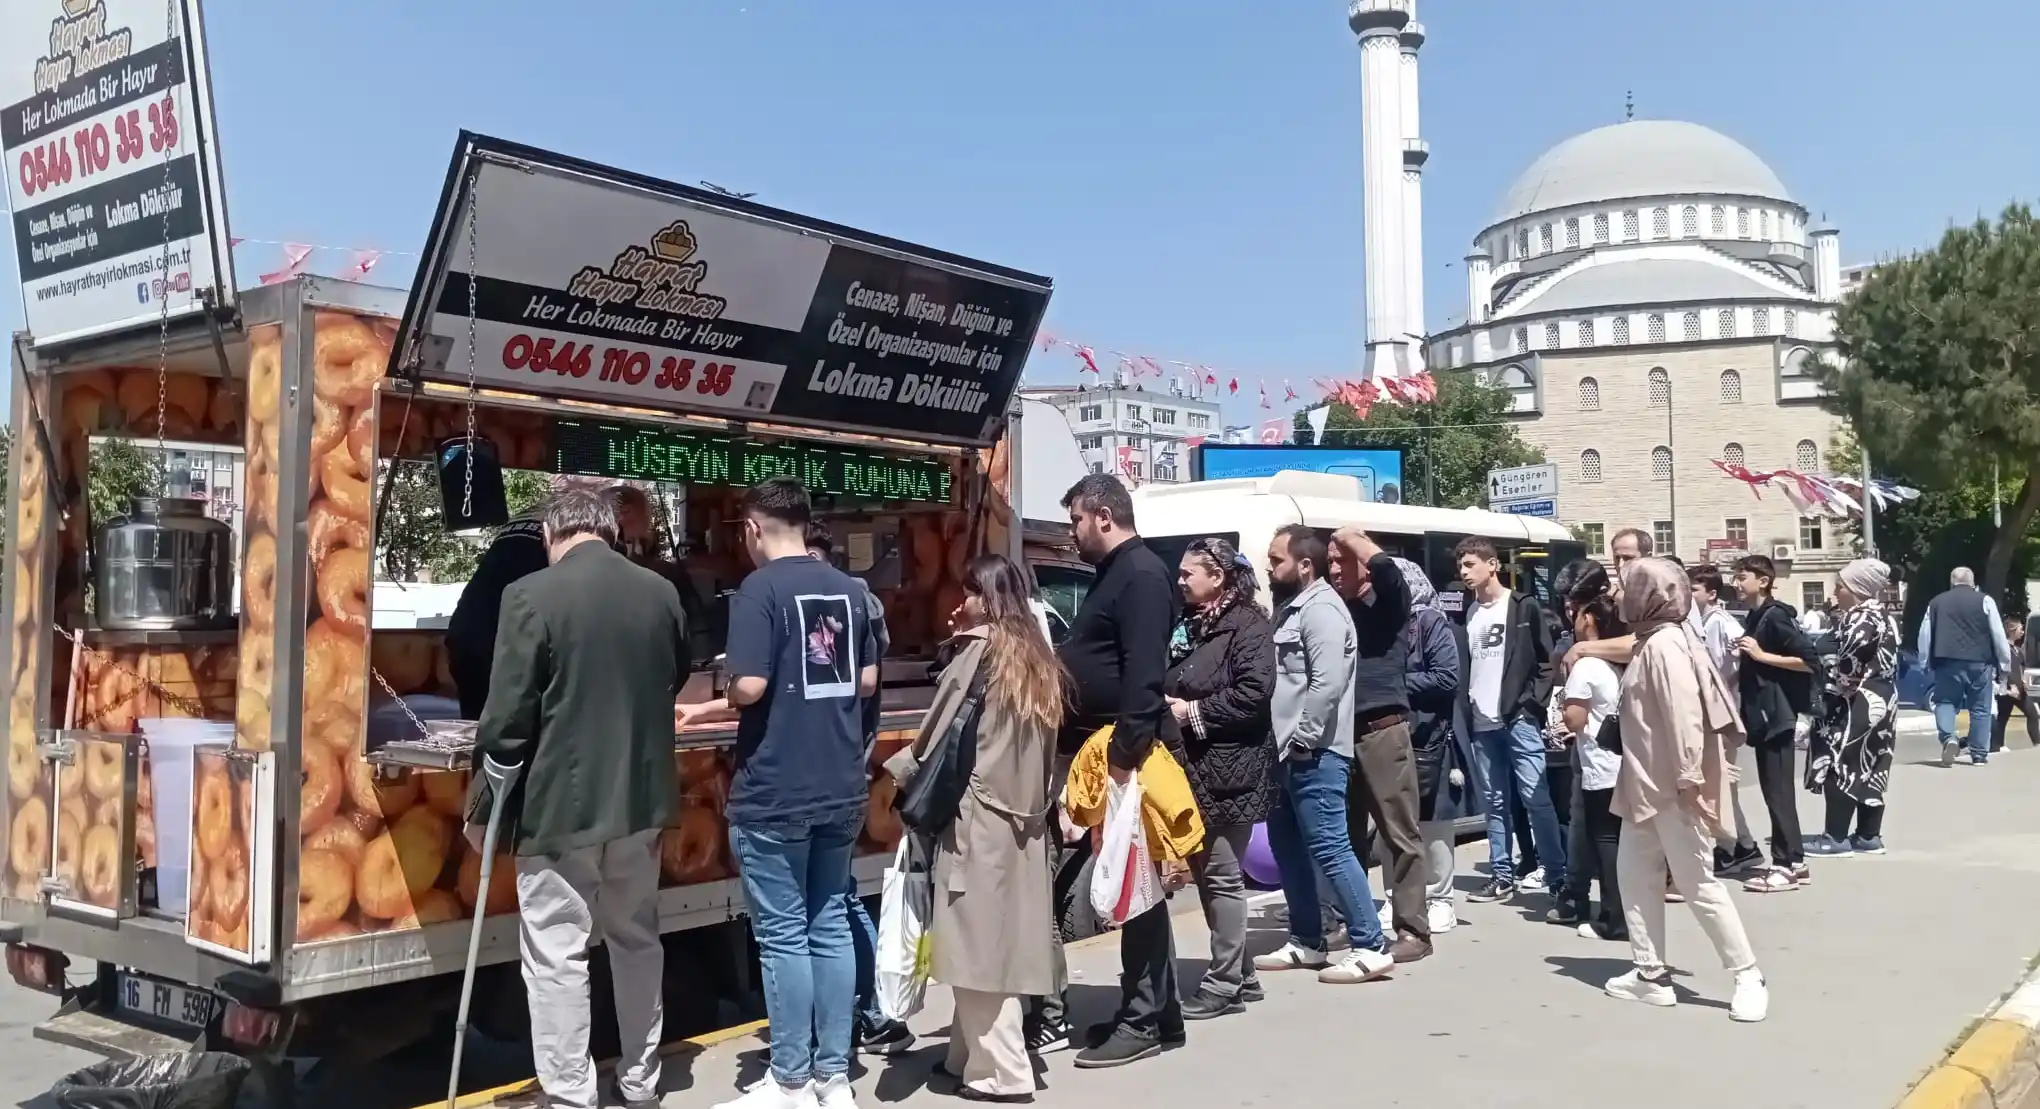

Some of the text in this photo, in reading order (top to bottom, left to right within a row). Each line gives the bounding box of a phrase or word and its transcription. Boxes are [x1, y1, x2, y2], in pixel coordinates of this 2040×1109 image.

[50, 1, 105, 57] Hayrat
[22, 63, 158, 135] Her Lokmada Bir Hayır
[19, 95, 178, 197] 0546 110 35 35
[105, 199, 140, 229] Lokma
[568, 269, 726, 319] Hayır Lokması
[612, 249, 705, 291] Hayrat
[522, 295, 743, 350] Her Lokmada Bir Hayır
[845, 280, 1014, 338] Cenaze, Nişan, Düğün ve
[502, 334, 736, 396] 0546 110 35 35
[827, 311, 1003, 375] Özel Organizasyonlar için
[807, 359, 990, 414] Lokma Dökülür
[608, 435, 729, 480] HÜSEYİN
[844, 463, 933, 497] RUHUNA
[1500, 471, 1548, 484] Güngören
[1502, 483, 1544, 495] Esenler
[126, 979, 209, 1025] 16 FM 598
